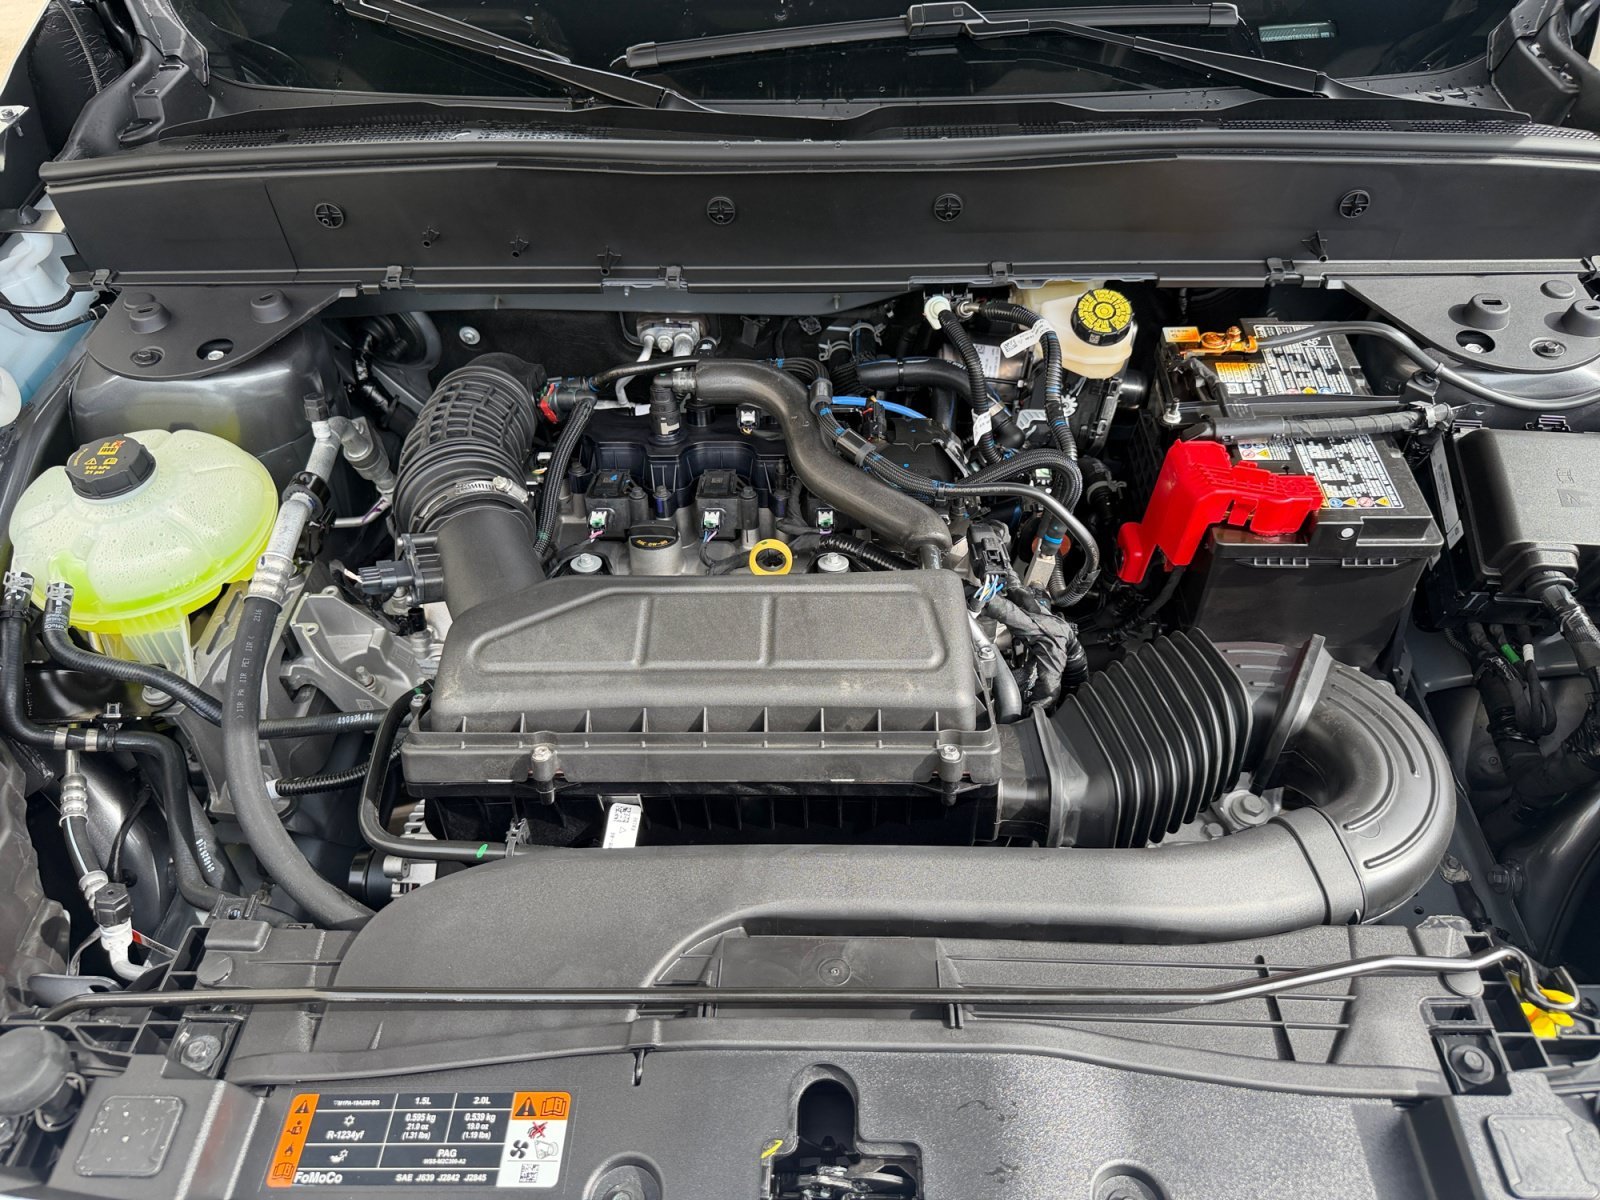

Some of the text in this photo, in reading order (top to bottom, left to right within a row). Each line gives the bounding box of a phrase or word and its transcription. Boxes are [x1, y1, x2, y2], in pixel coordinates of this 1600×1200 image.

[241, 658, 250, 667] PET
[405, 1114, 436, 1124] 0.595 kg
[464, 1113, 496, 1124] 0.539 kg
[325, 1130, 364, 1140] R-1234yf
[419, 1132, 431, 1140] lbs)
[478, 1132, 491, 1140] lbs)
[436, 1149, 457, 1157] PAG
[294, 1172, 343, 1184] FoMoCo
[395, 1174, 413, 1182] SAE
